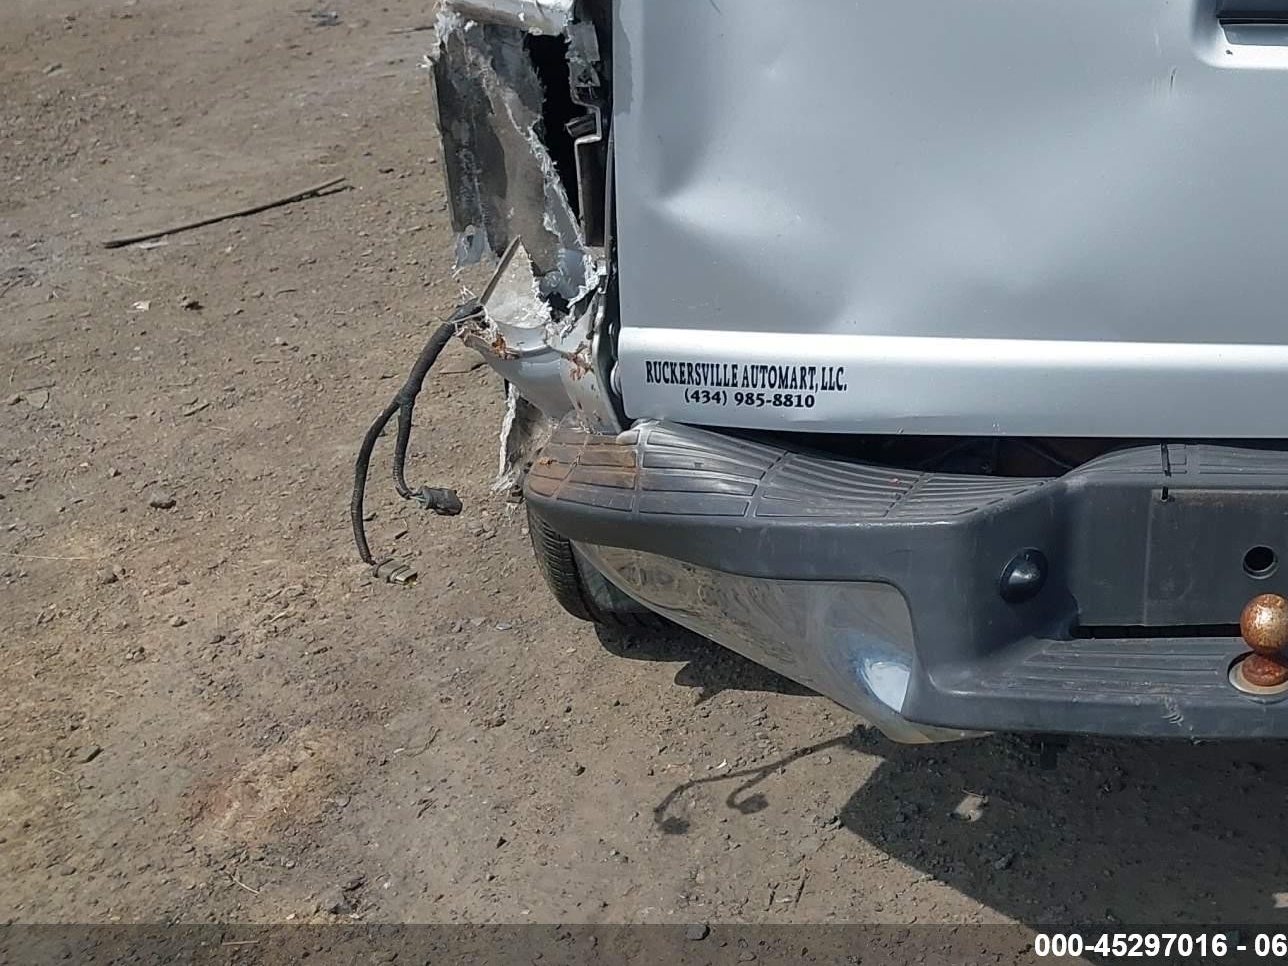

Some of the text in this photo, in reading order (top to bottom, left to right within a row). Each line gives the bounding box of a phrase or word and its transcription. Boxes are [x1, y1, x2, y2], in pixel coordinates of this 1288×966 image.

[645, 360, 848, 393] RUCKERSVILLE AUTOMART, LLC.
[684, 387, 816, 409] (434) 985-8810
